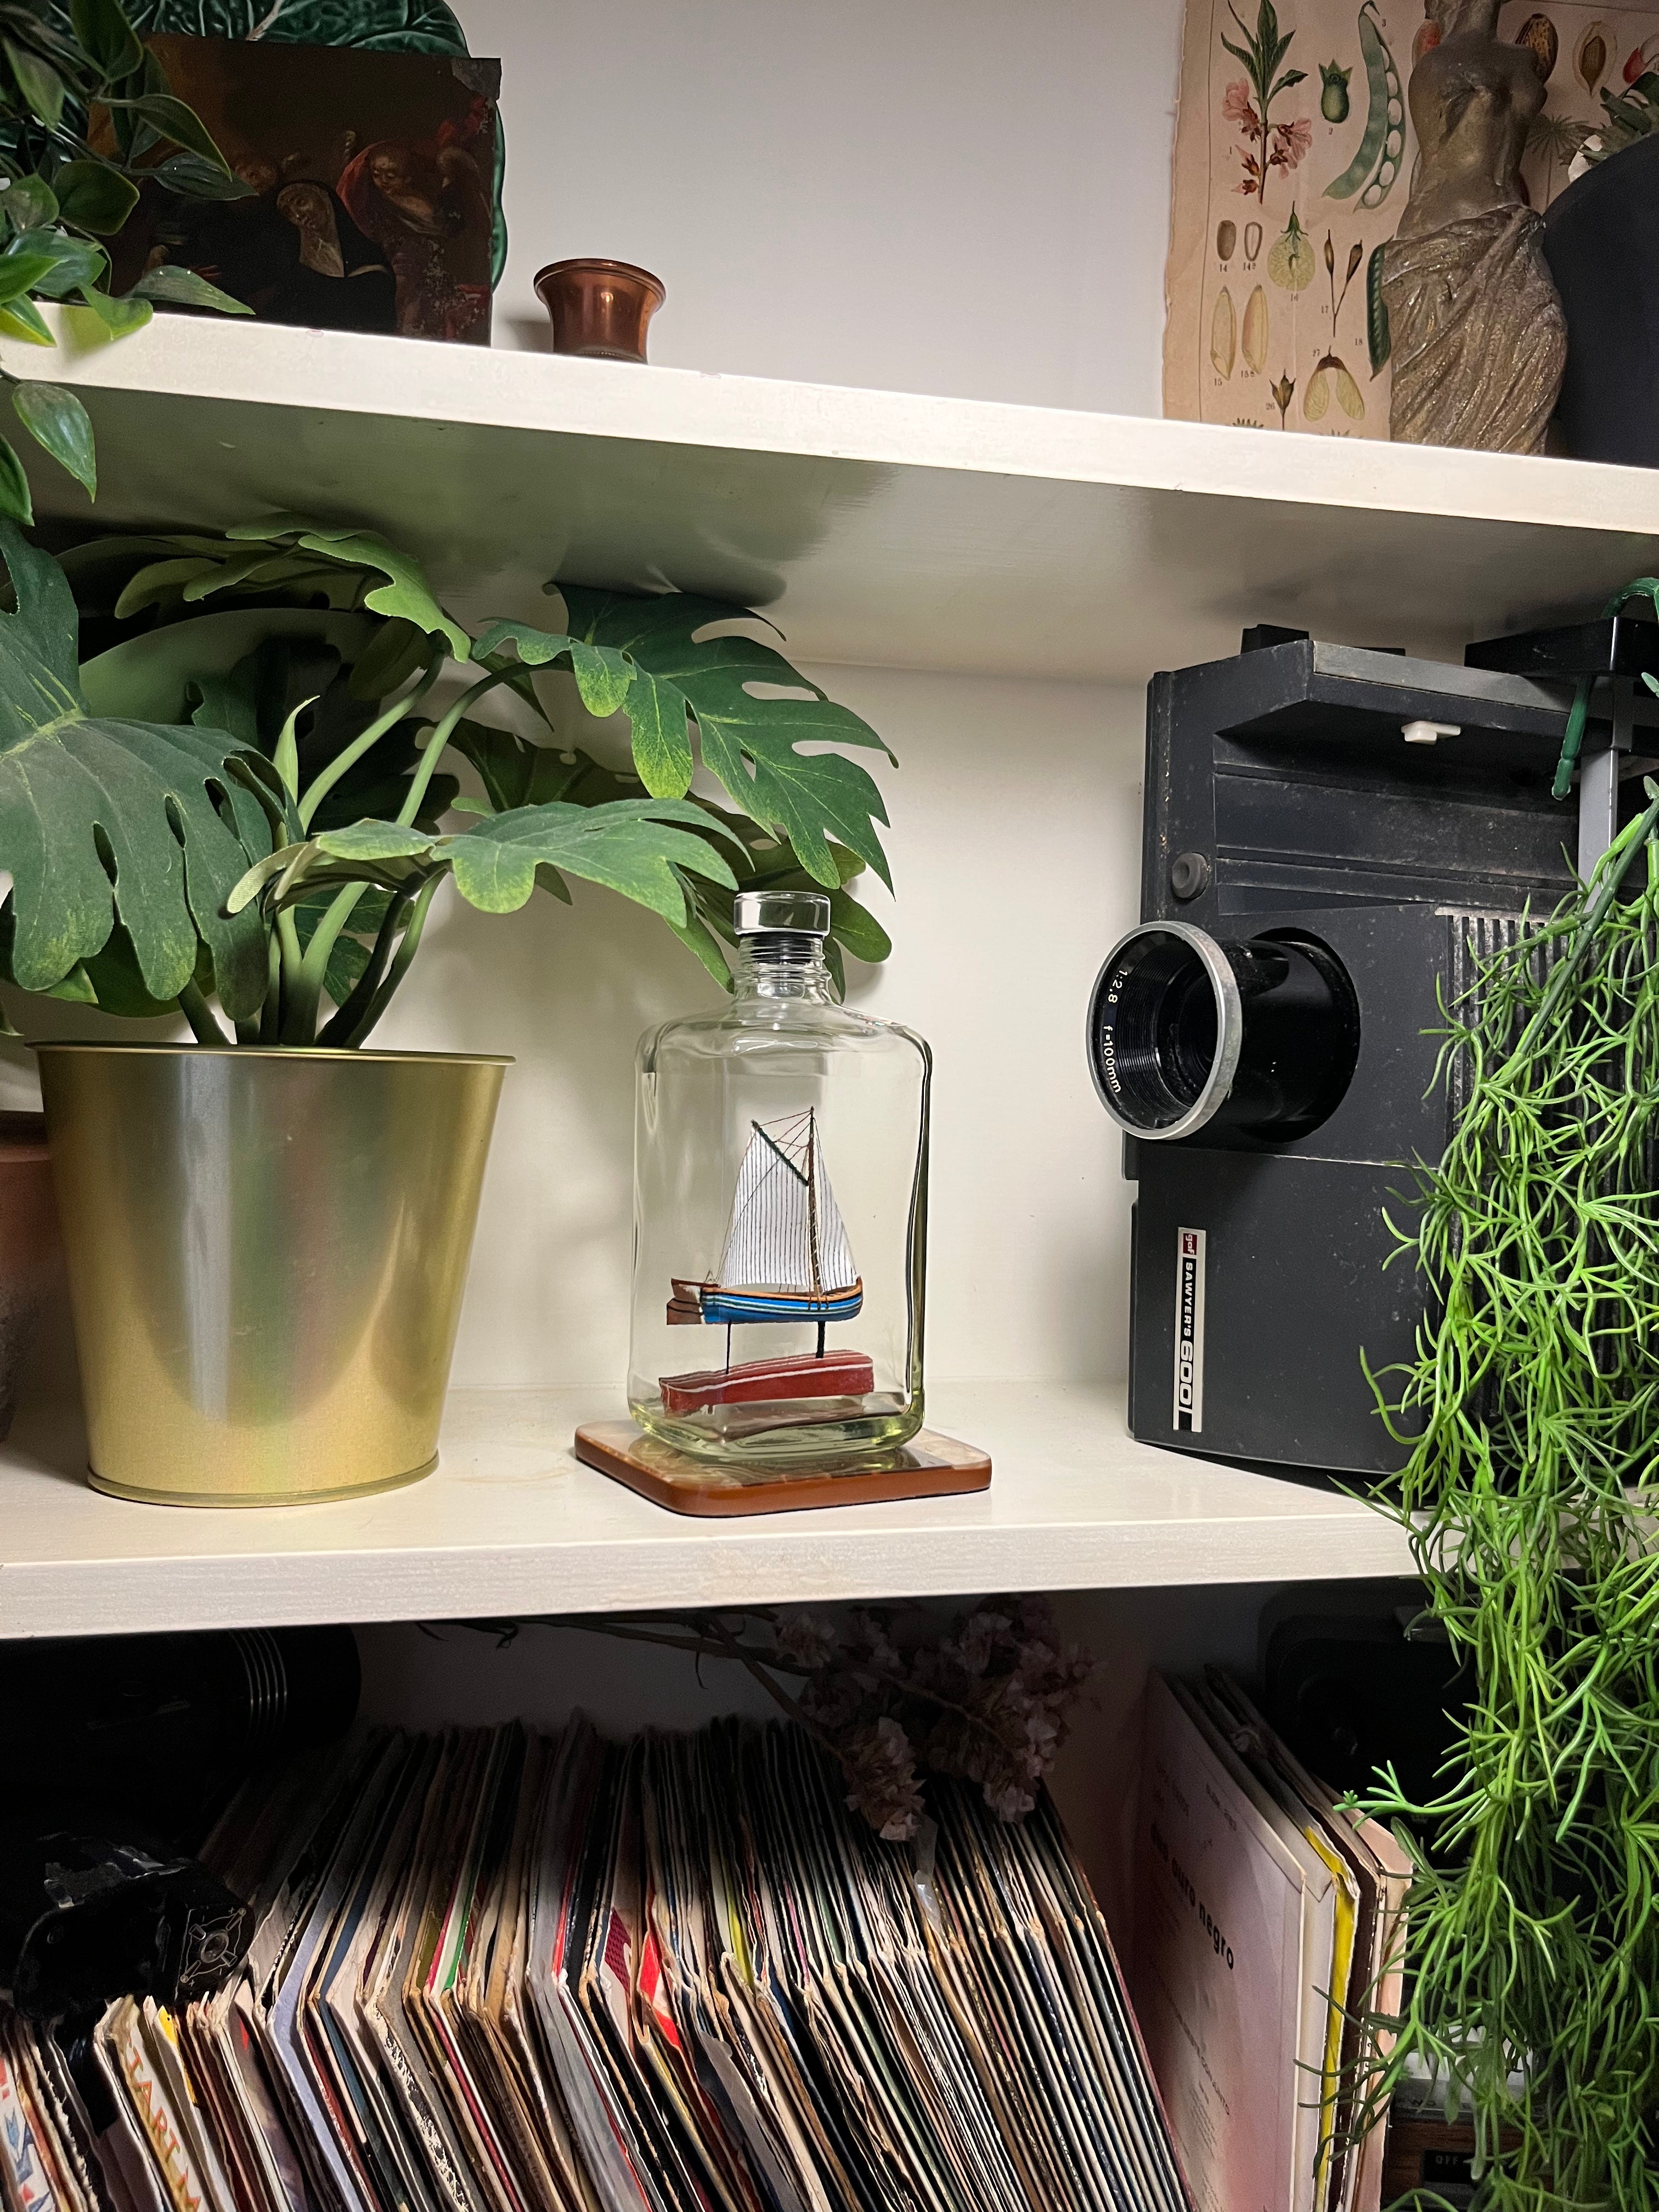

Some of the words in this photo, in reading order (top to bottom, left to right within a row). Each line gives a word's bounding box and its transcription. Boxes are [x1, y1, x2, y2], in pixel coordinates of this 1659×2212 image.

[1108, 970, 1128, 1003] 1:2.8
[1103, 1025, 1121, 1093] f=100mm
[1184, 1262, 1193, 1336] SAWYER'S
[1180, 1340, 1193, 1406] 600
[1199, 1901, 1234, 1970] negro
[129, 2036, 180, 2162] TART
